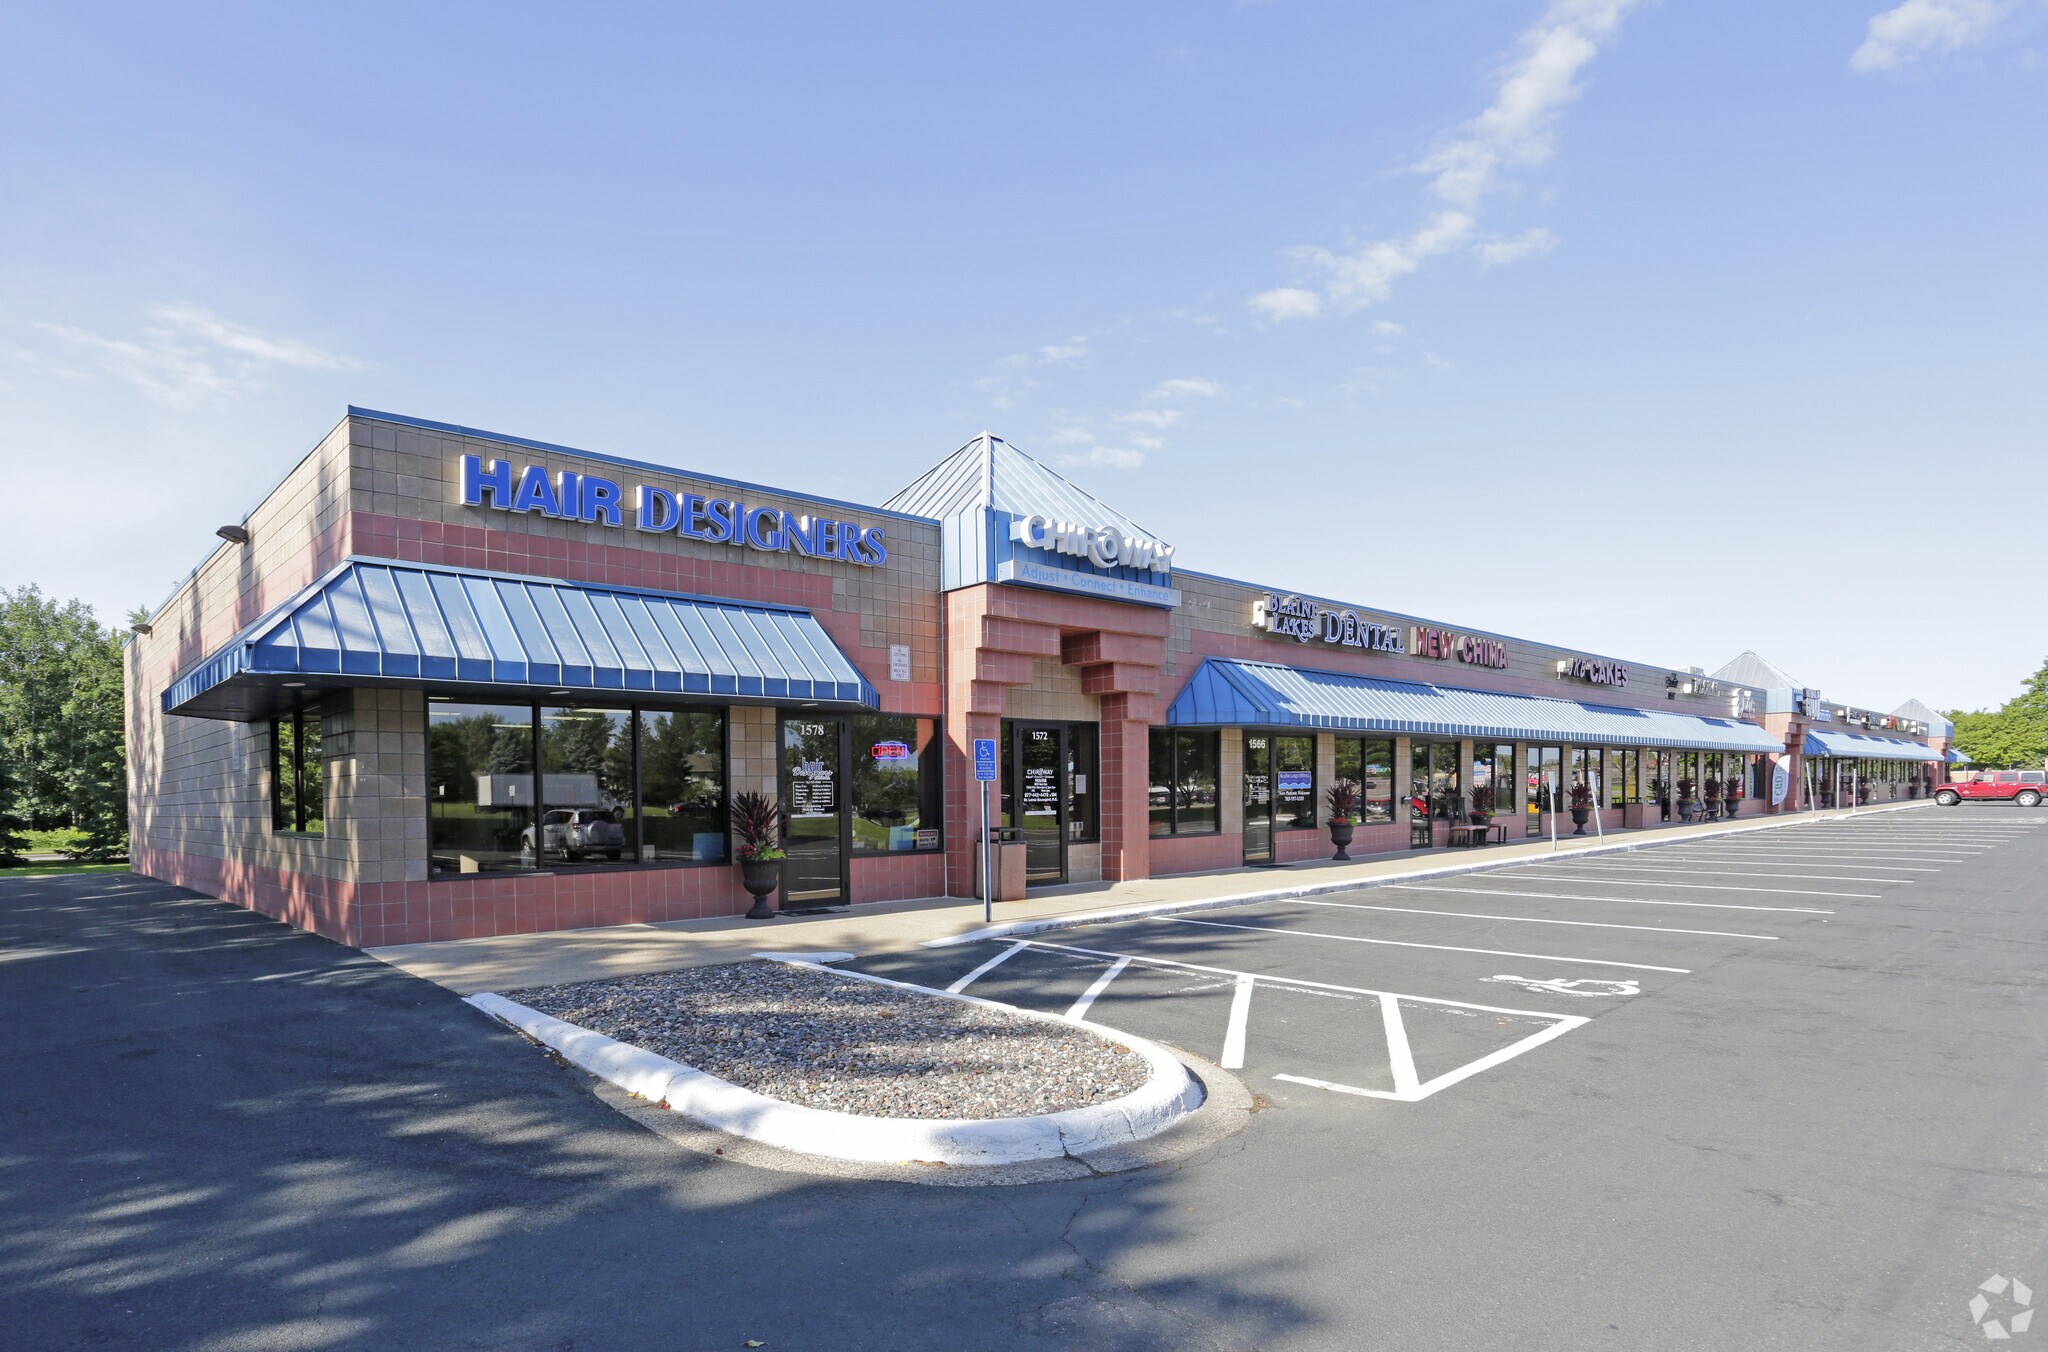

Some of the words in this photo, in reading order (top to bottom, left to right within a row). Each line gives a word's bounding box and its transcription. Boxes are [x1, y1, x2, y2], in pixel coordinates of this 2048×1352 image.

[460, 453, 622, 527] HAIR
[636, 484, 887, 567] DESIGNERS
[1020, 514, 1176, 573] CHIROWAY
[1021, 564, 1061, 583] Adjust
[1072, 572, 1117, 593] Connect
[1128, 583, 1169, 601] Enhance
[1268, 592, 1319, 619] BLAINE
[1271, 612, 1316, 643] LAKES
[1325, 610, 1404, 653] DENTAL
[1413, 626, 1455, 660] NEW
[1460, 635, 1509, 669] CHINA
[1590, 658, 1630, 687] CAKES
[800, 724, 824, 736] 1578
[1032, 731, 1048, 740] 1572
[872, 746, 905, 757] OPEN
[1249, 739, 1265, 749] 1566
[801, 756, 824, 772] hair
[1775, 776, 1783, 796] CBD
